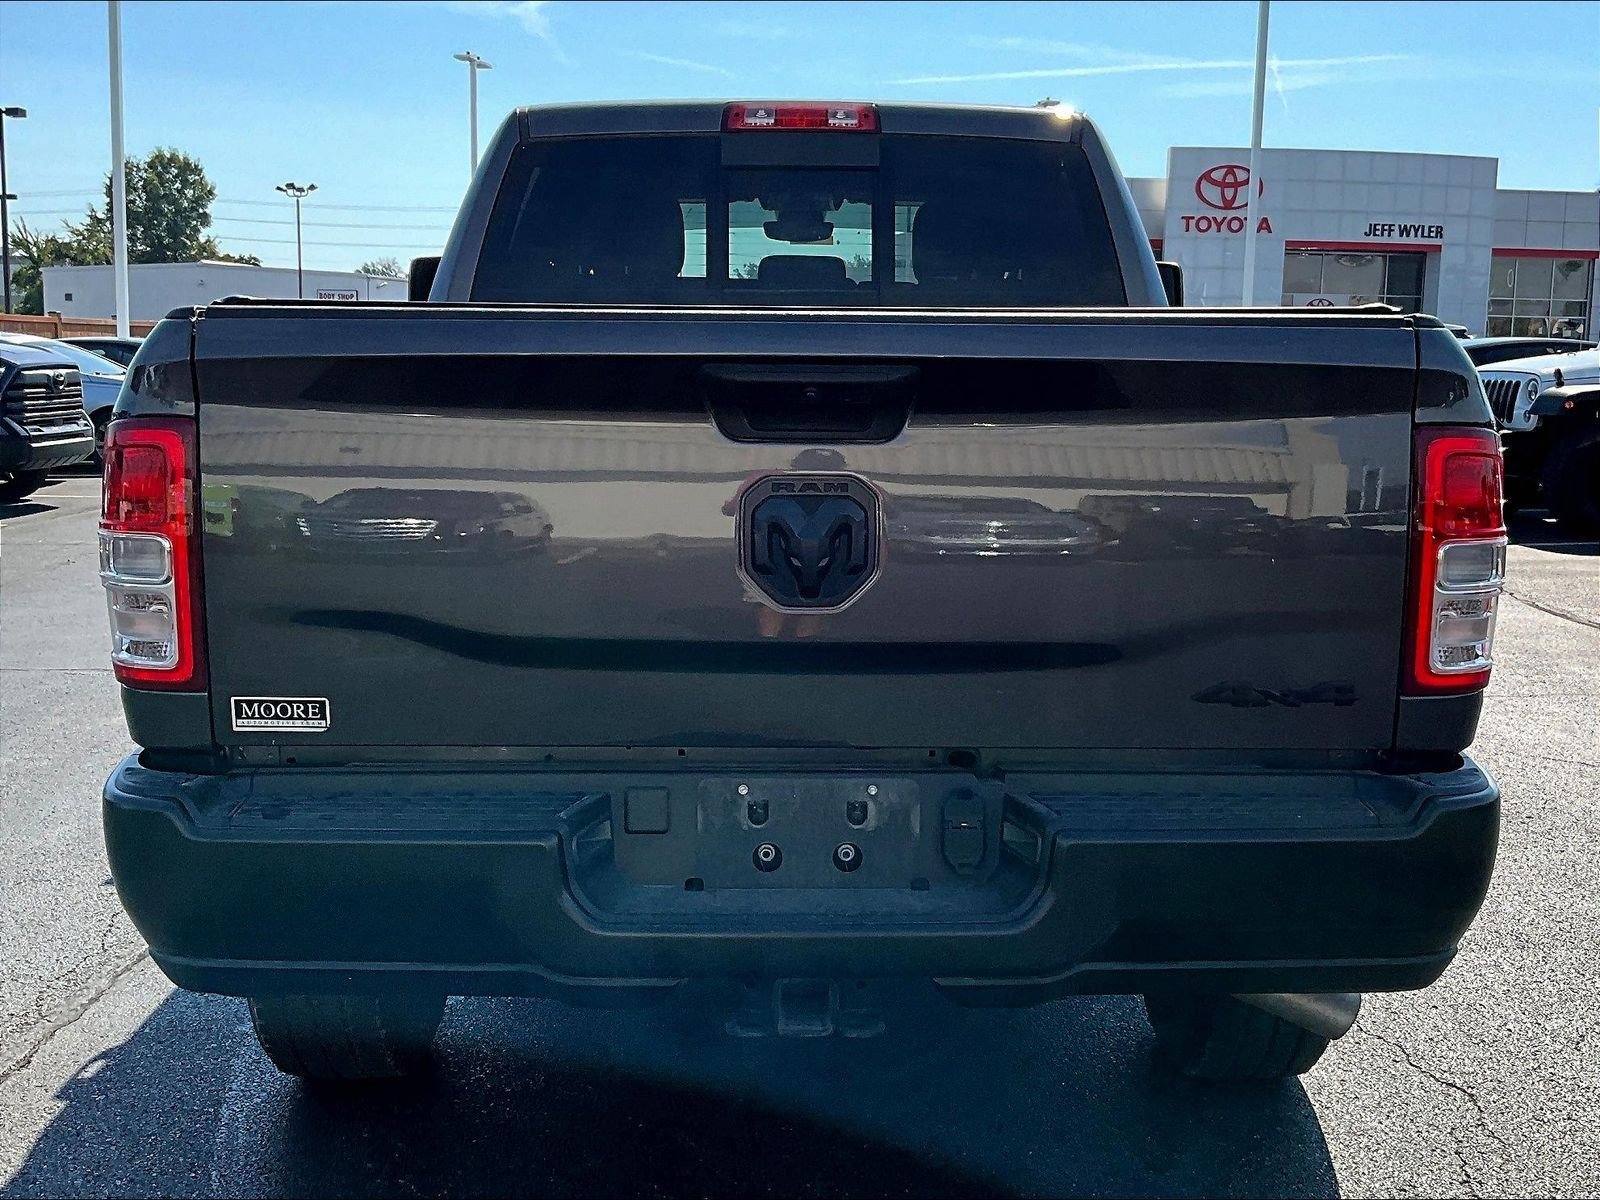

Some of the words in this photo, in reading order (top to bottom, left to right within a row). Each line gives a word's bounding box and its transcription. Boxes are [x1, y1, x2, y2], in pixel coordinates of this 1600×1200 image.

[1181, 216, 1272, 233] TOYOA
[1364, 223, 1396, 237] JEFF
[1398, 224, 1444, 239] WYLER
[771, 482, 849, 493] RAM
[240, 702, 321, 718] MOORE
